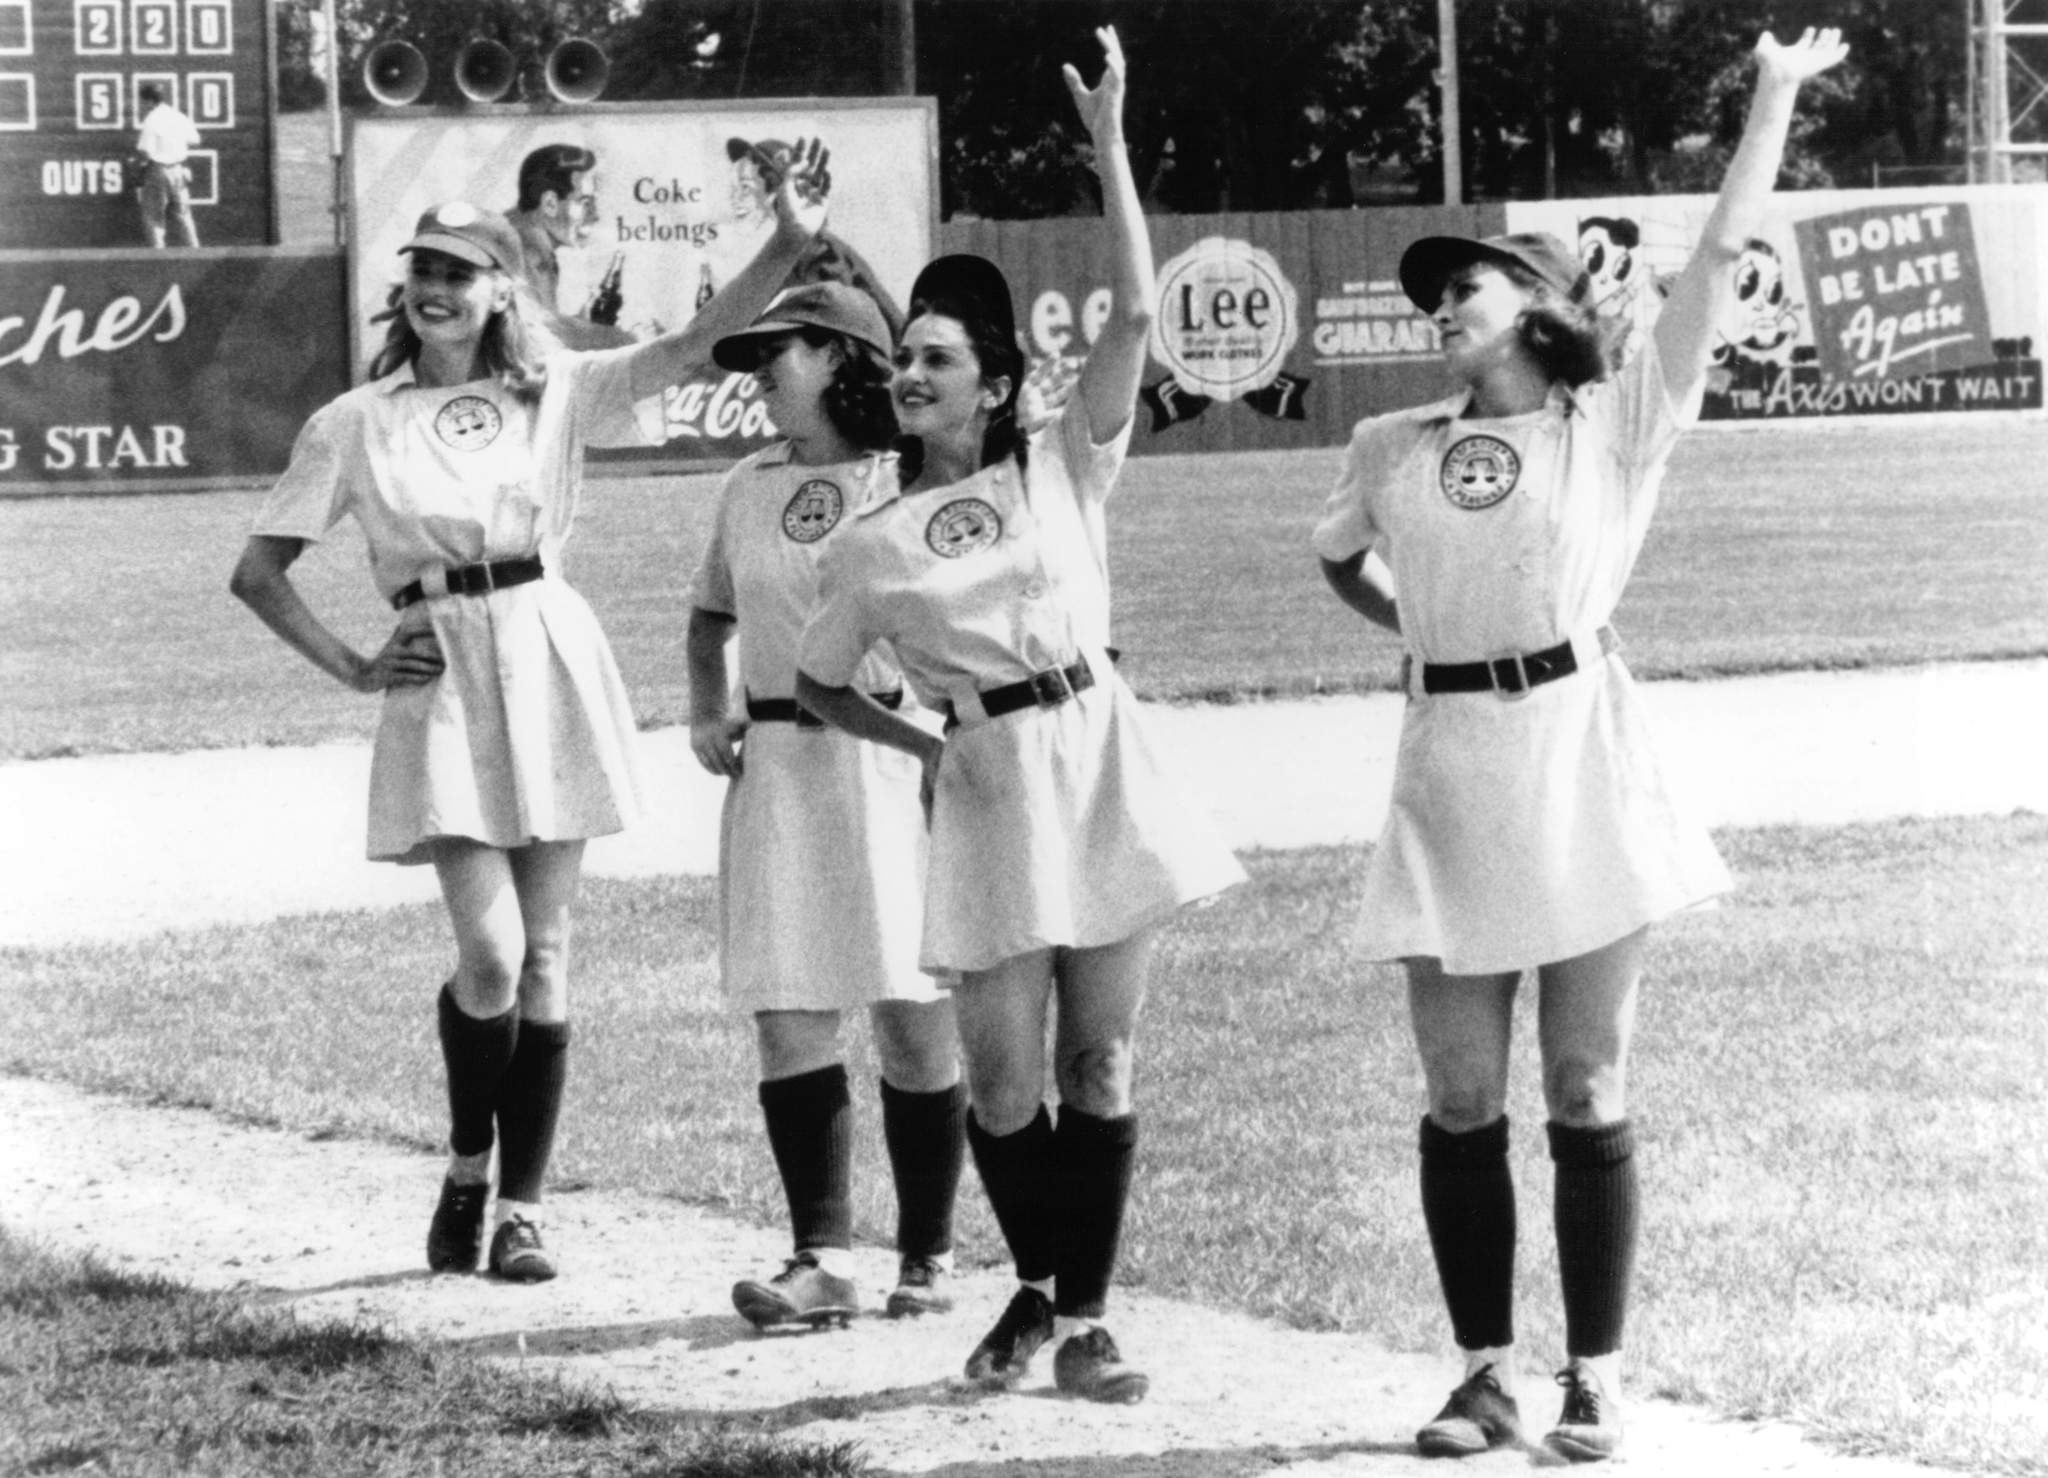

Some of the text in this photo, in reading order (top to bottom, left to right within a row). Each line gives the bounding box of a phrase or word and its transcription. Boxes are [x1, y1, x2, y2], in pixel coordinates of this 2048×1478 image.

[89, 9, 219, 44] 2 2 0
[91, 83, 220, 119] 5 0
[42, 160, 123, 195] OUTS
[633, 177, 703, 204] Coke
[616, 215, 720, 248] belongs
[1819, 251, 1962, 305] BE LATE
[1179, 283, 1270, 331] Lee
[1840, 289, 1964, 378] Again
[1729, 367, 2035, 414] THE Axis WON'T WAIT
[45, 424, 189, 470] STAR
